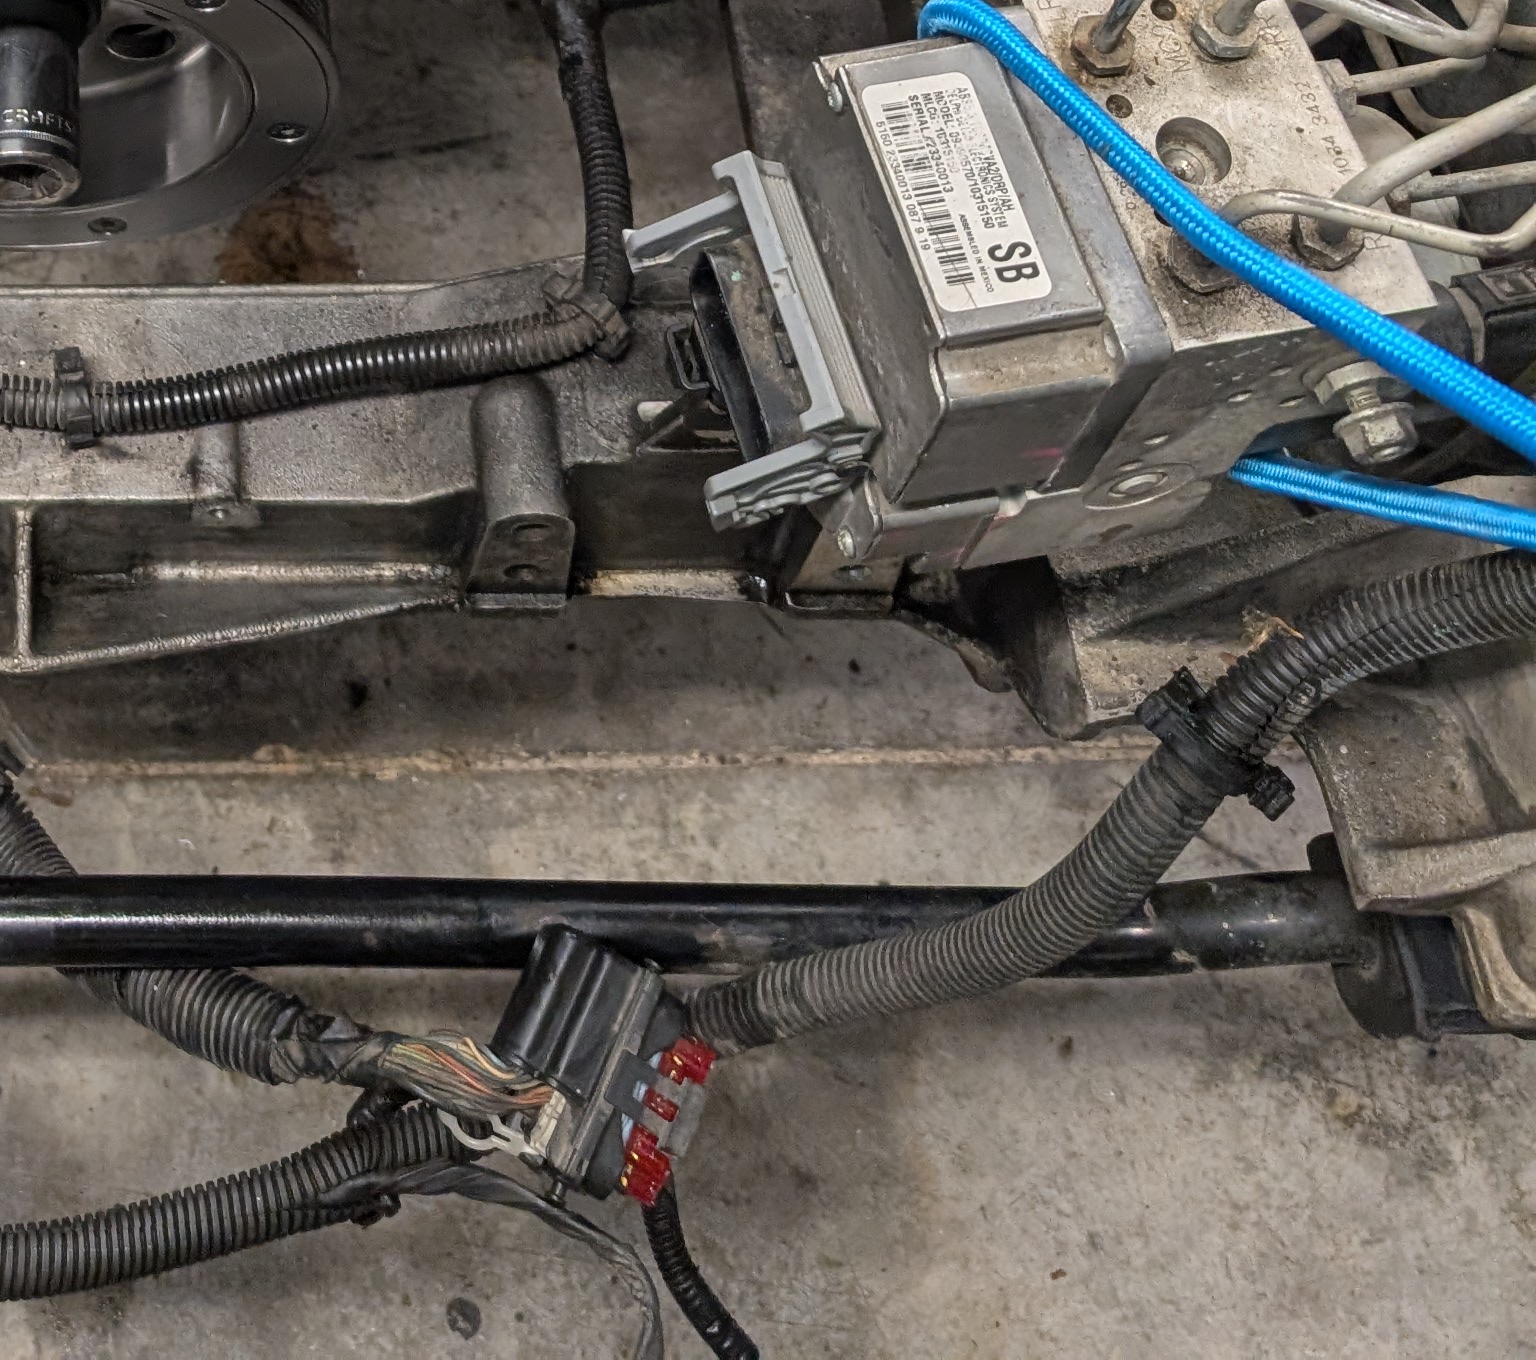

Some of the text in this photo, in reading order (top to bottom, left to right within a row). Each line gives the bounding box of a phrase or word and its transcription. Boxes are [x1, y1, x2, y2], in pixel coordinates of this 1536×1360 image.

[907, 93, 931, 132] SERIAL
[886, 149, 913, 200] 23340013
[906, 203, 922, 223] 087
[918, 238, 932, 251] 19
[948, 131, 994, 228] 09570/10315150
[966, 143, 998, 194] LECTRONICS
[986, 196, 1008, 227] SYSTEM
[958, 214, 994, 292] ASSEMBLED IN MEXICO
[988, 241, 1039, 282] SB
